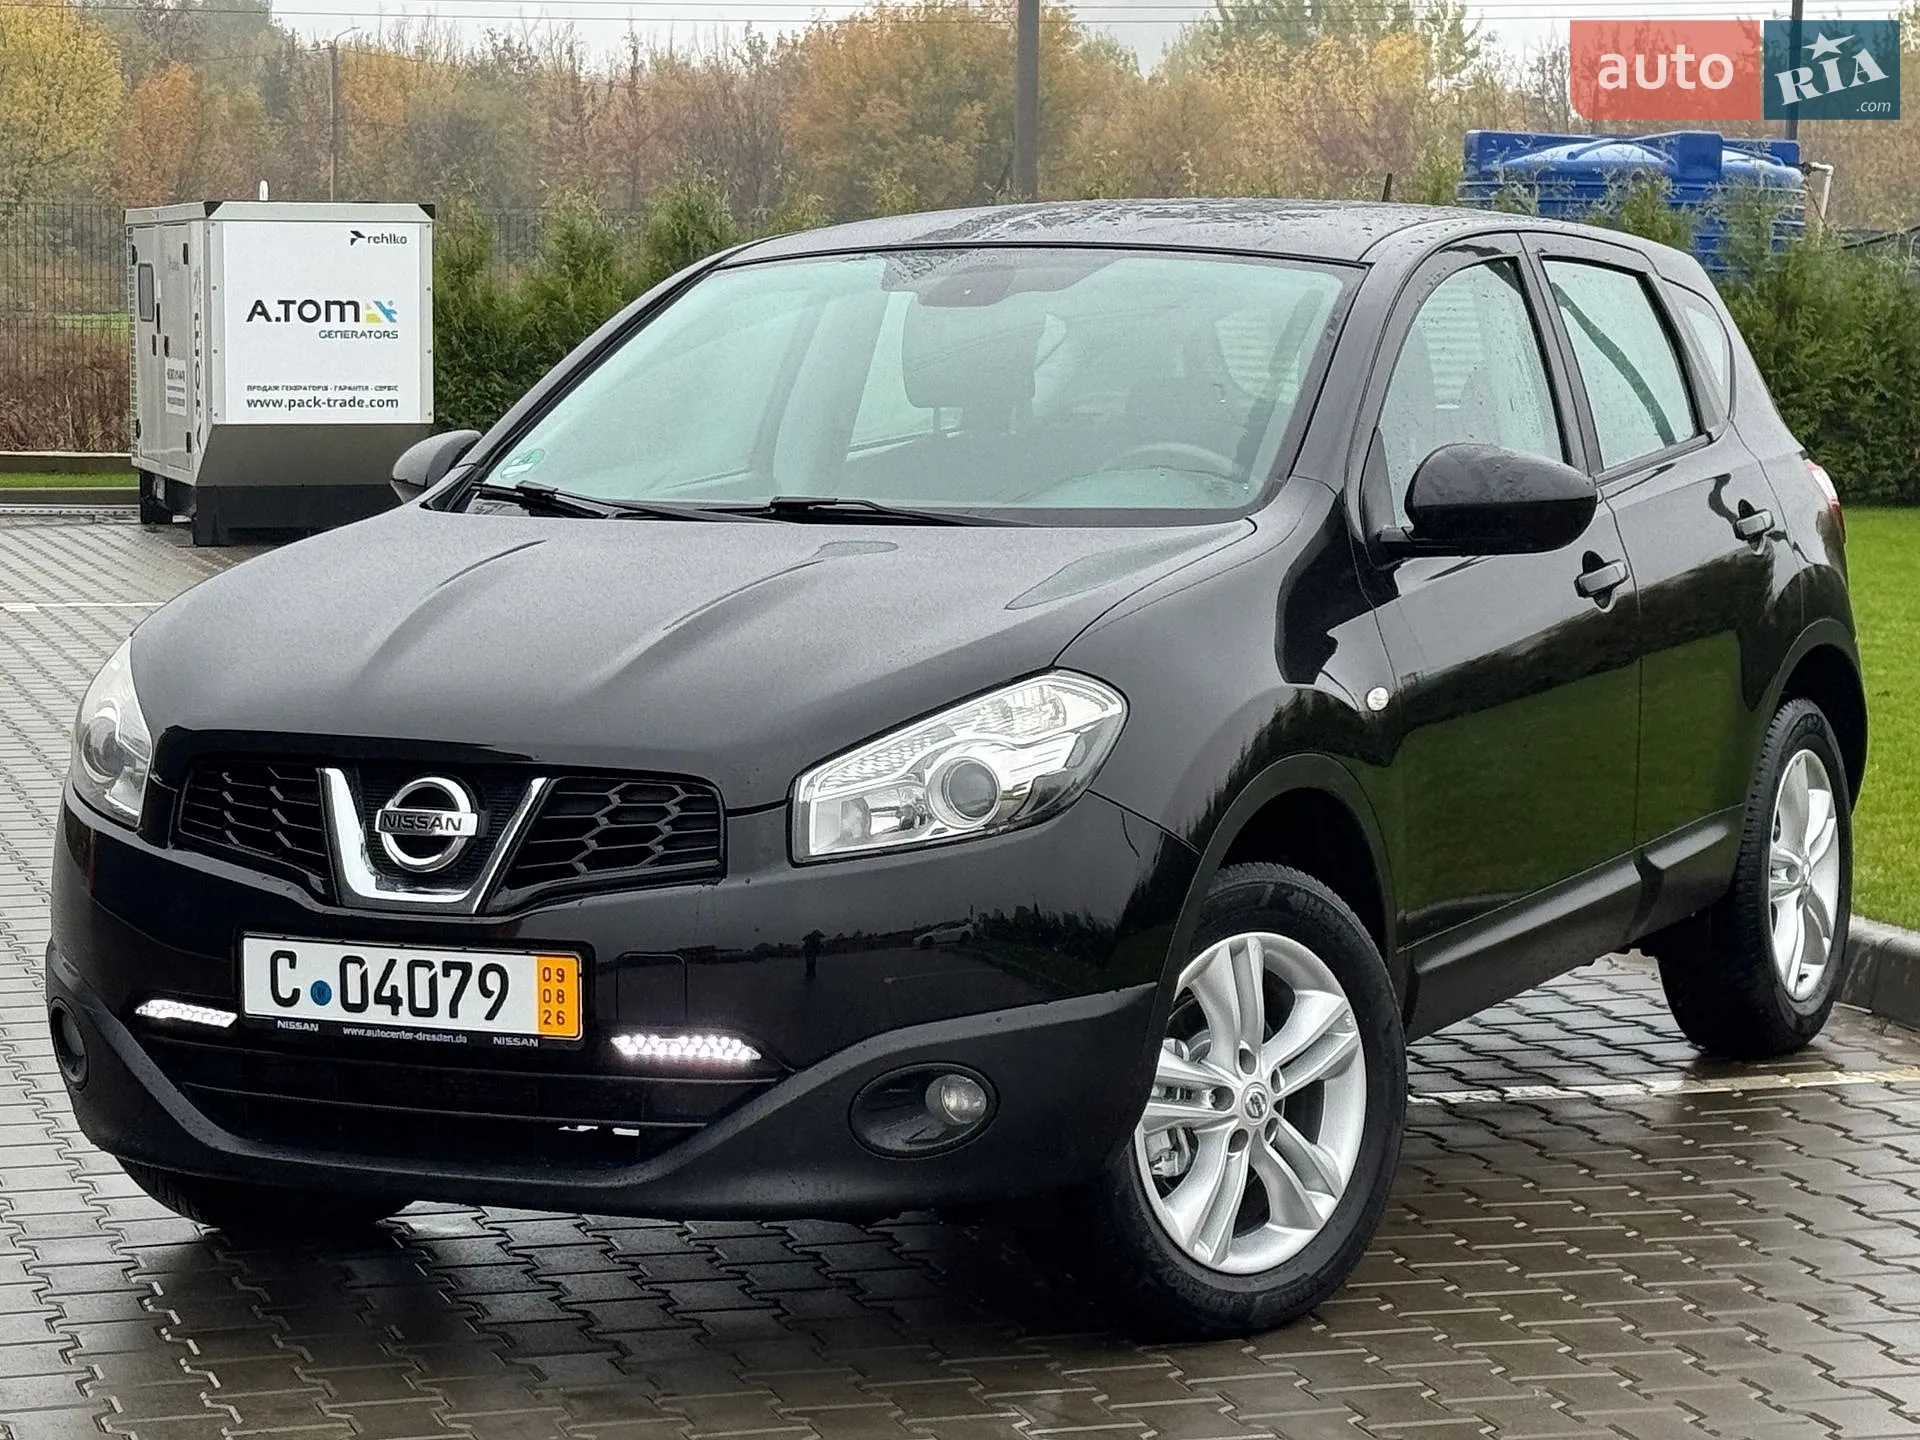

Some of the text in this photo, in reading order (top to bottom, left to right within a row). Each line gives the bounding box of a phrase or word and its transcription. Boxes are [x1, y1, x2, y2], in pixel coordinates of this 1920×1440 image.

[318, 329, 399, 340] GENERATORS
[246, 396, 399, 411] www.pack-trade.com
[382, 812, 462, 831] NISSAN
[541, 966, 566, 983] 09
[269, 949, 510, 1021] C 04079
[541, 988, 566, 1005] 08
[276, 1019, 320, 1032] NISSAN
[542, 1009, 566, 1026] 26
[492, 1036, 539, 1048] NISSAN
